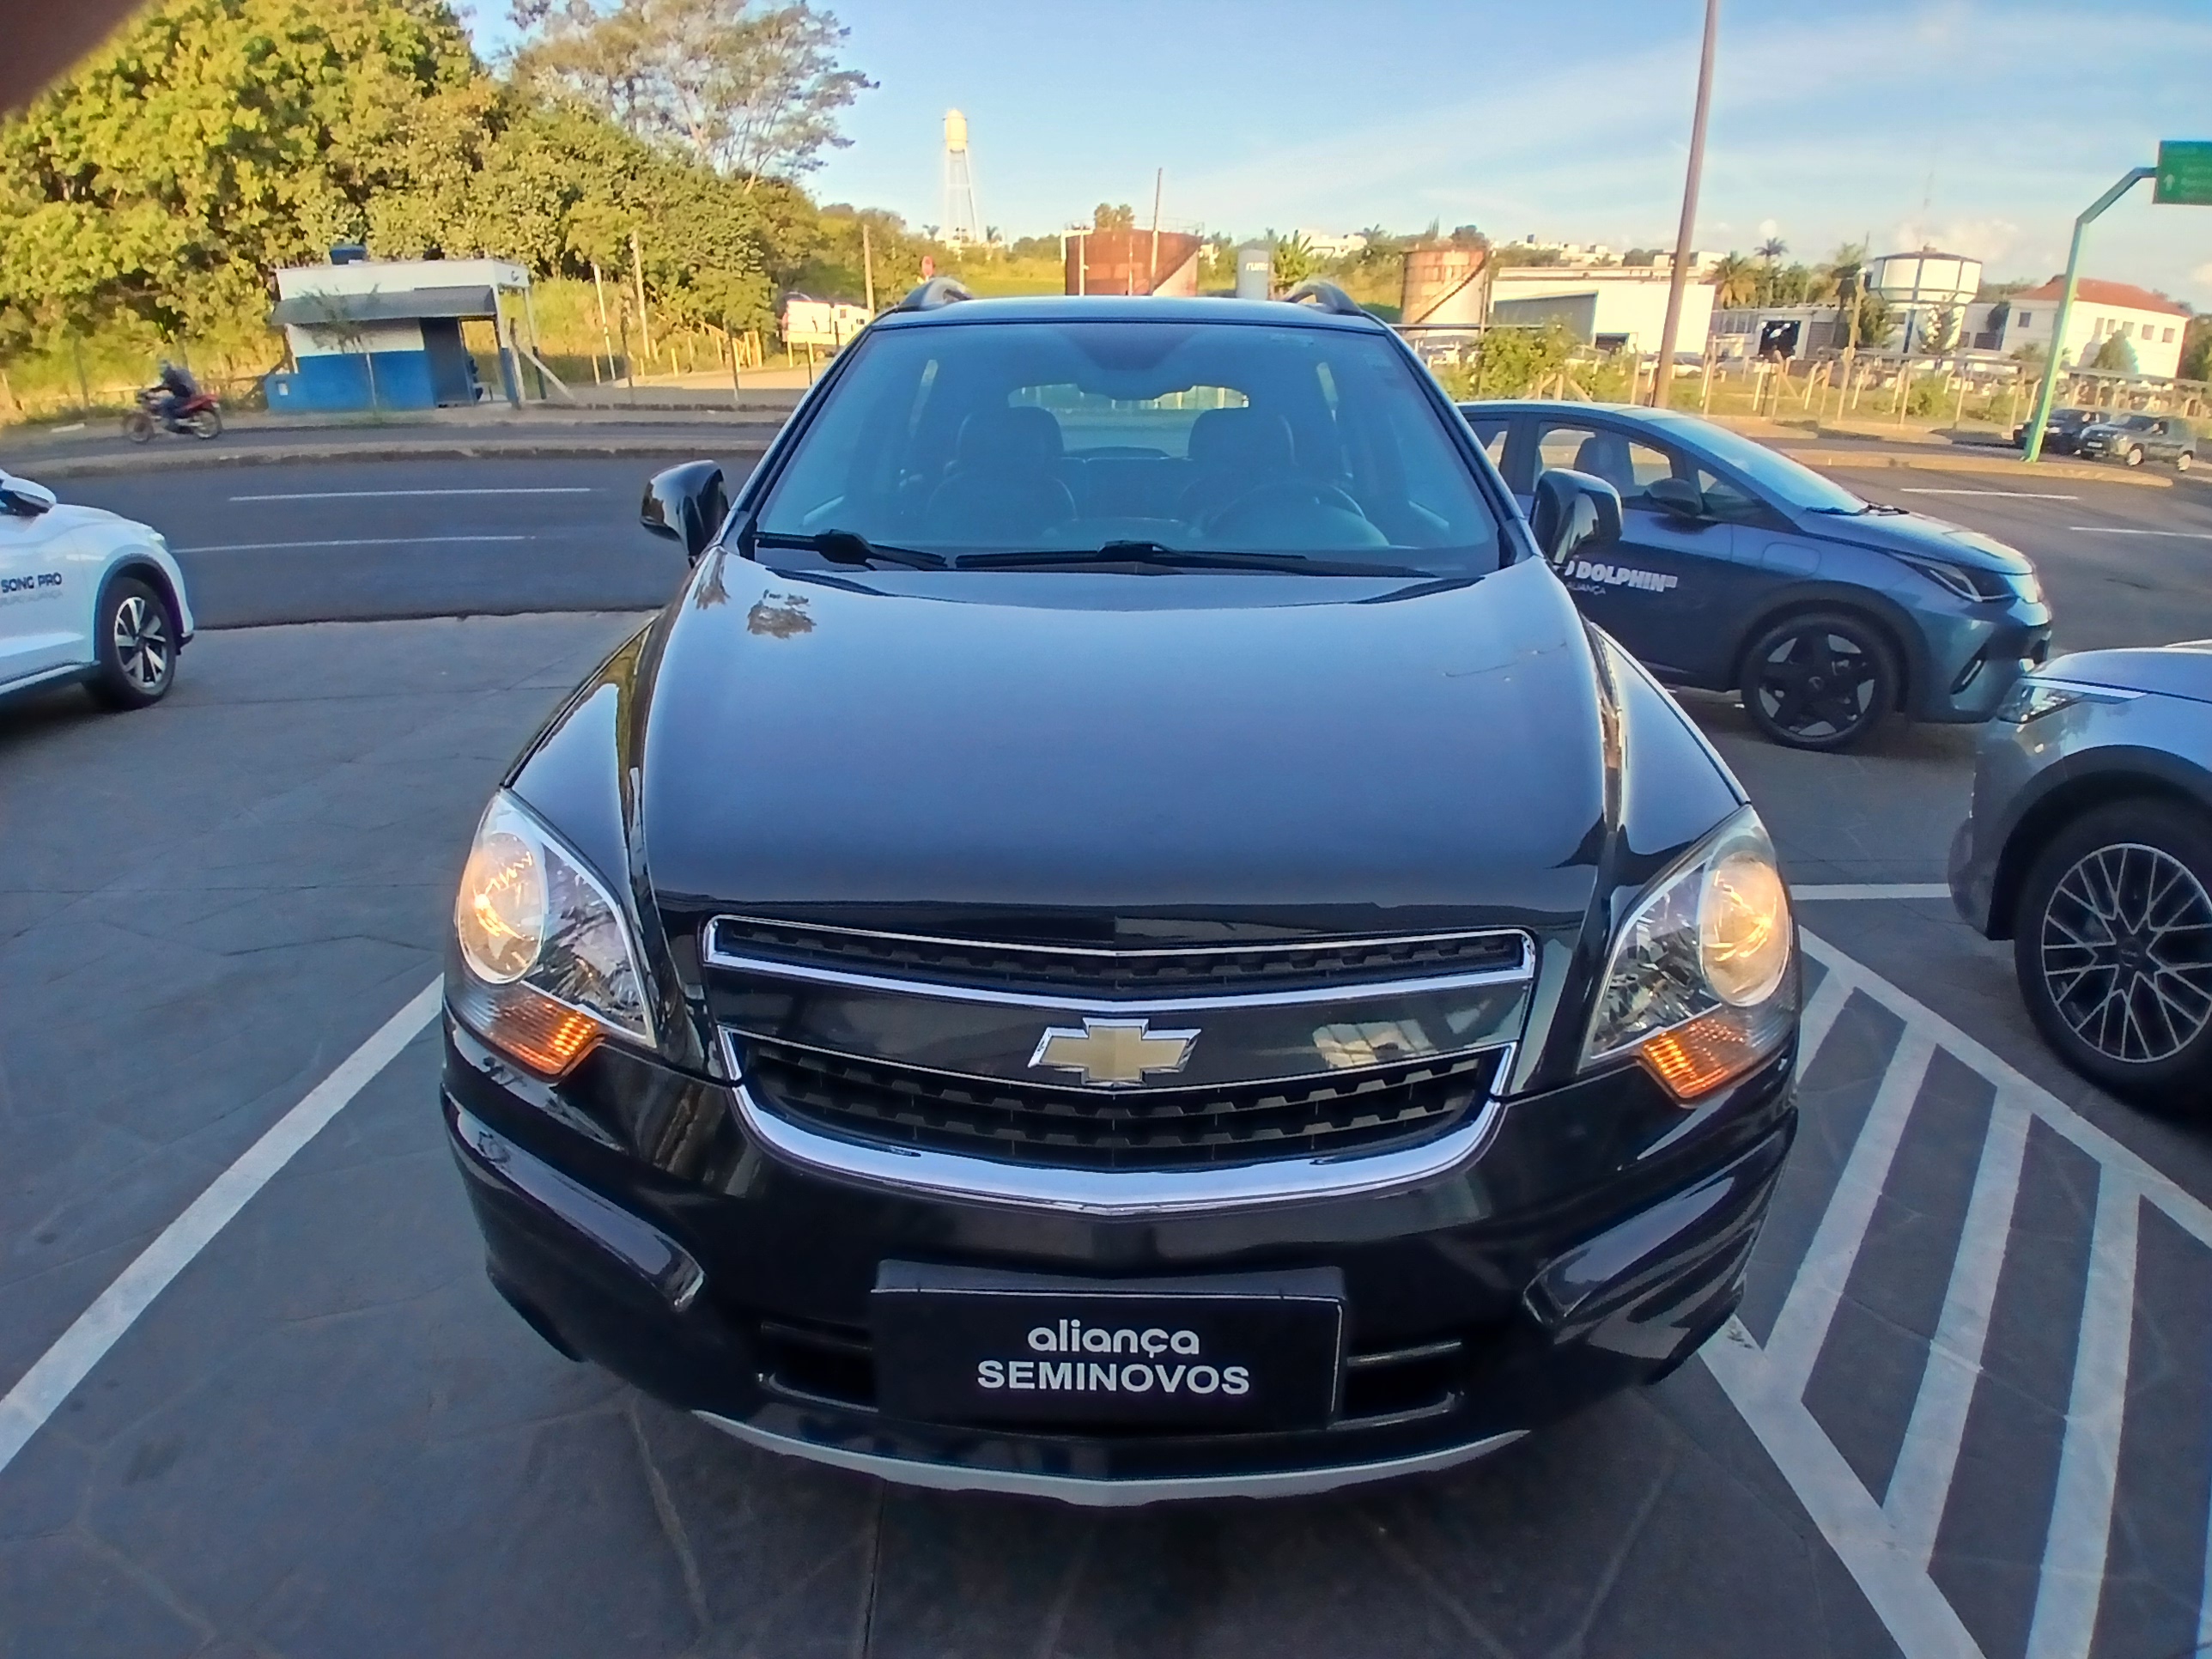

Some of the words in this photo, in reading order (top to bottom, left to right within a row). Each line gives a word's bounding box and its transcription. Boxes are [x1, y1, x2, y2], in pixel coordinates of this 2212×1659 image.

[1, 575, 34, 593] SONG
[37, 572, 63, 587] PRO
[1576, 561, 1666, 592] DOLPHIN
[1027, 1319, 1200, 1358] aliança
[977, 1359, 1249, 1395] SEMINOVOS
